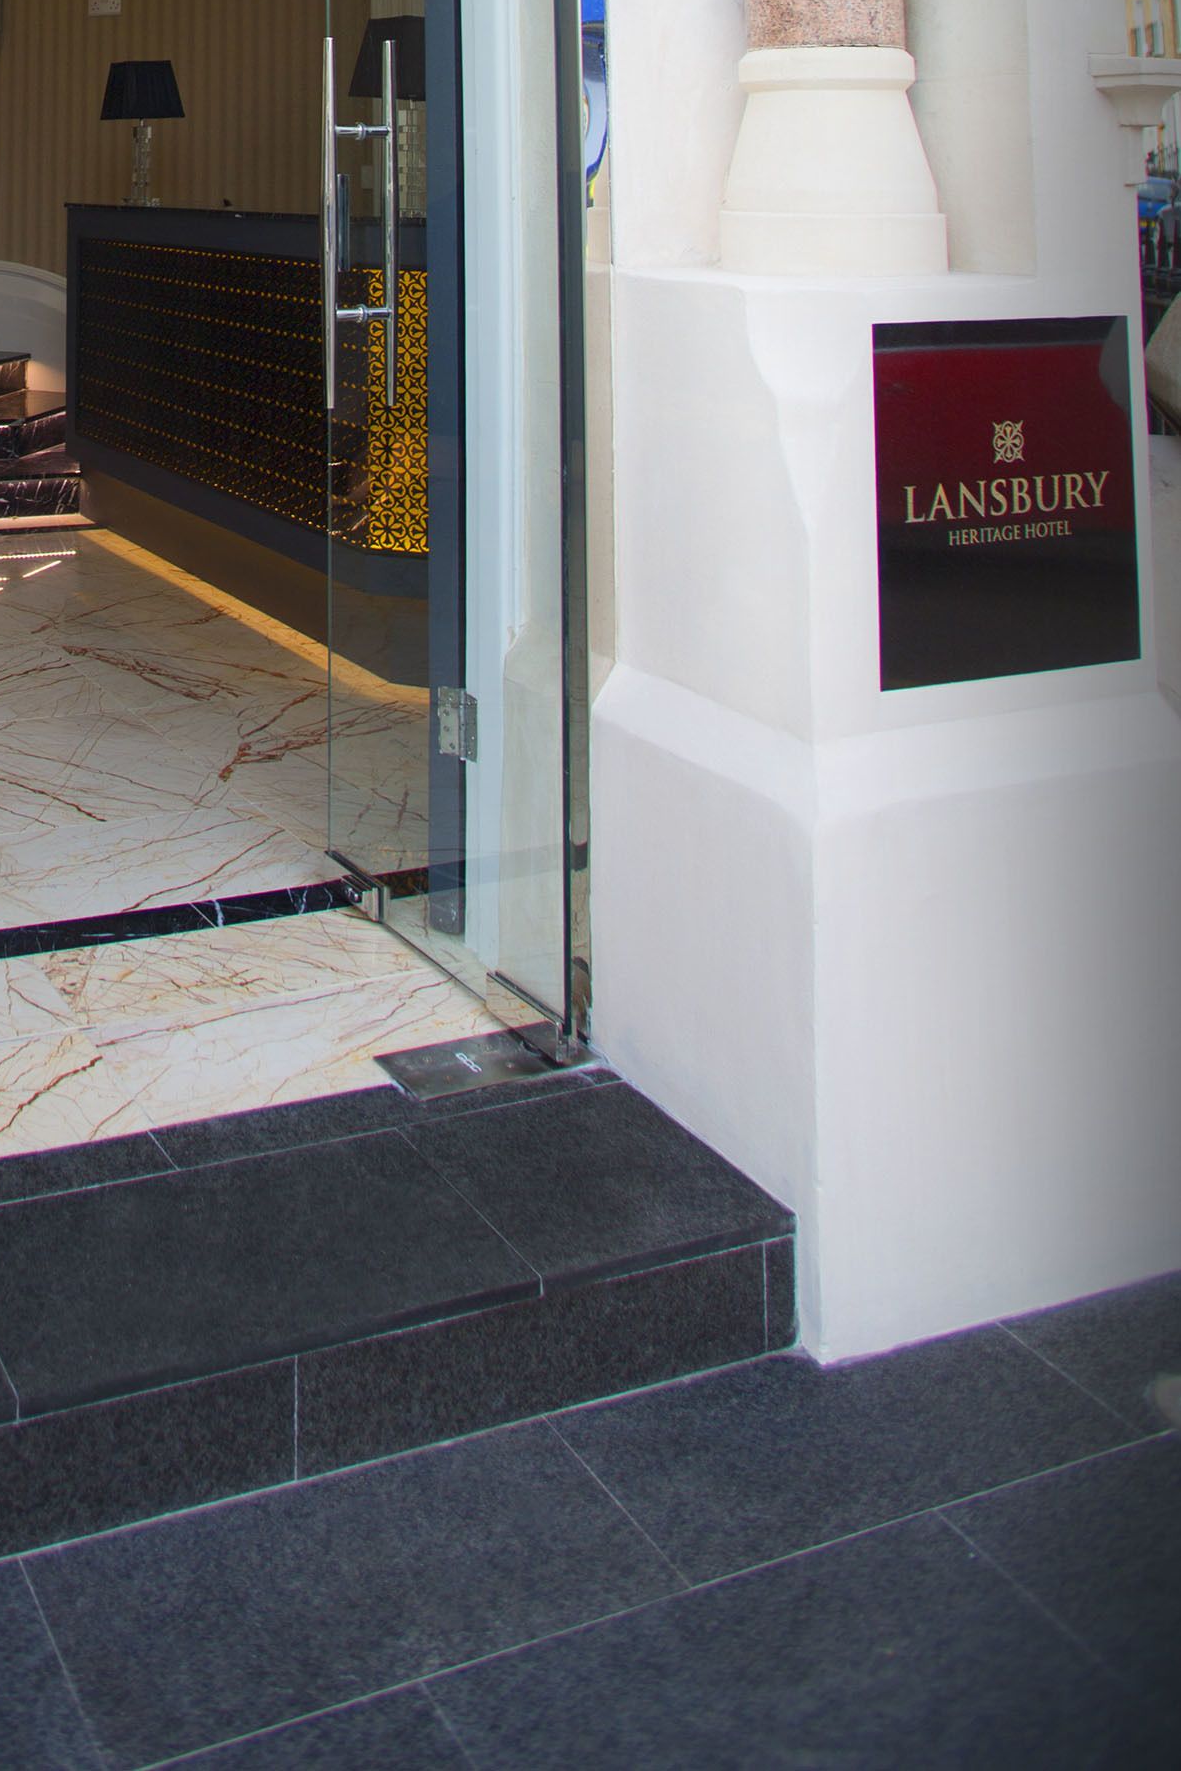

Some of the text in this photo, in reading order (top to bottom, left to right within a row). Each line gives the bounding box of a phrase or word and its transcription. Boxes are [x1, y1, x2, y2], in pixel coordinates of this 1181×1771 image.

[904, 470, 1110, 524] LANSBURY
[948, 521, 1072, 546] HERITAGE HOTEL
